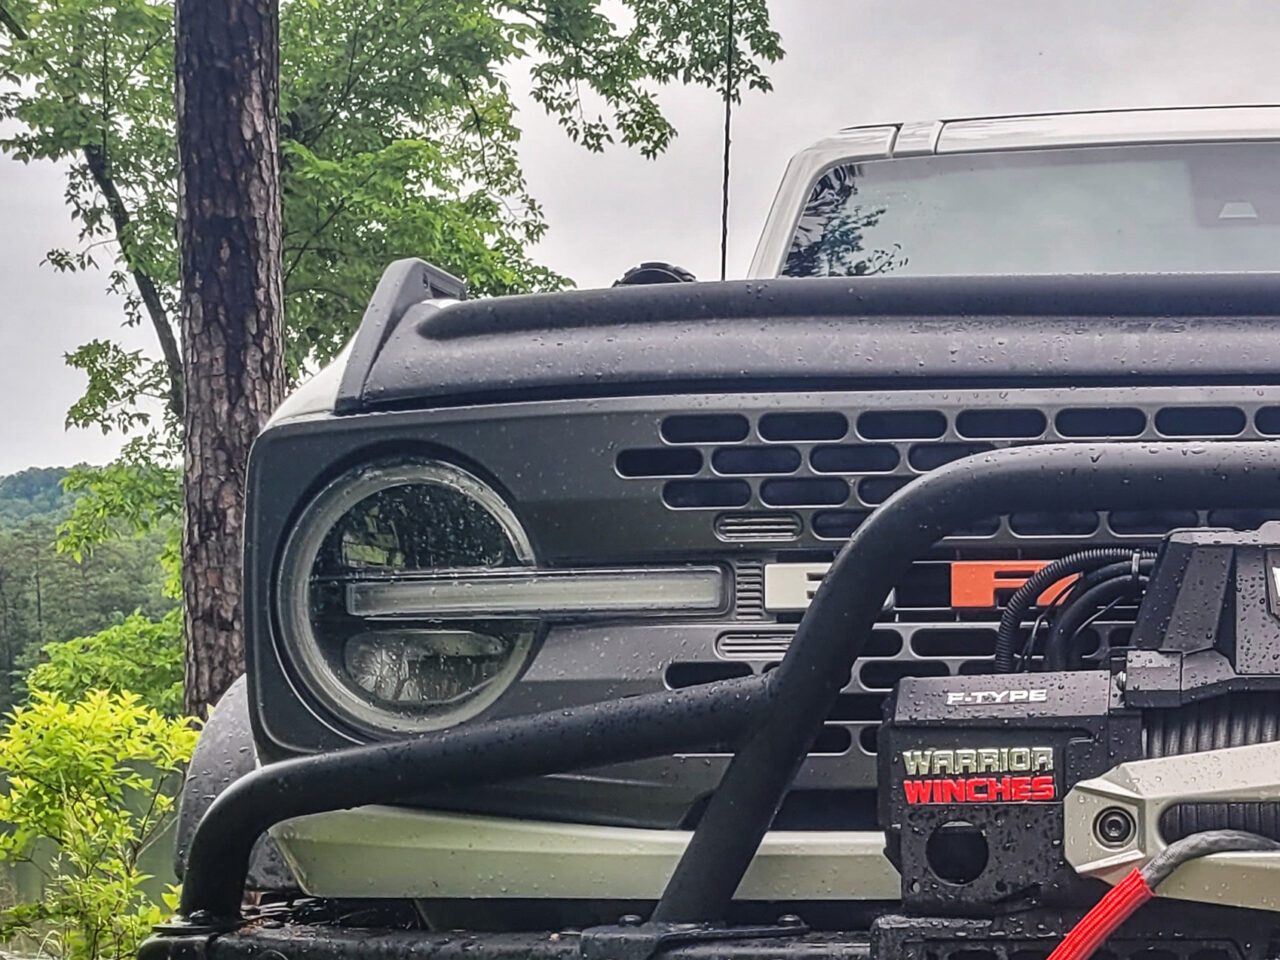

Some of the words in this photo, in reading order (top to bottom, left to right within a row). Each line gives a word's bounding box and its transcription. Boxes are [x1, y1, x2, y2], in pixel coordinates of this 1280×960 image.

[946, 689, 1048, 705] F-TYPE
[902, 747, 1054, 775] WARRIOR
[903, 776, 1055, 805] WINCHES
